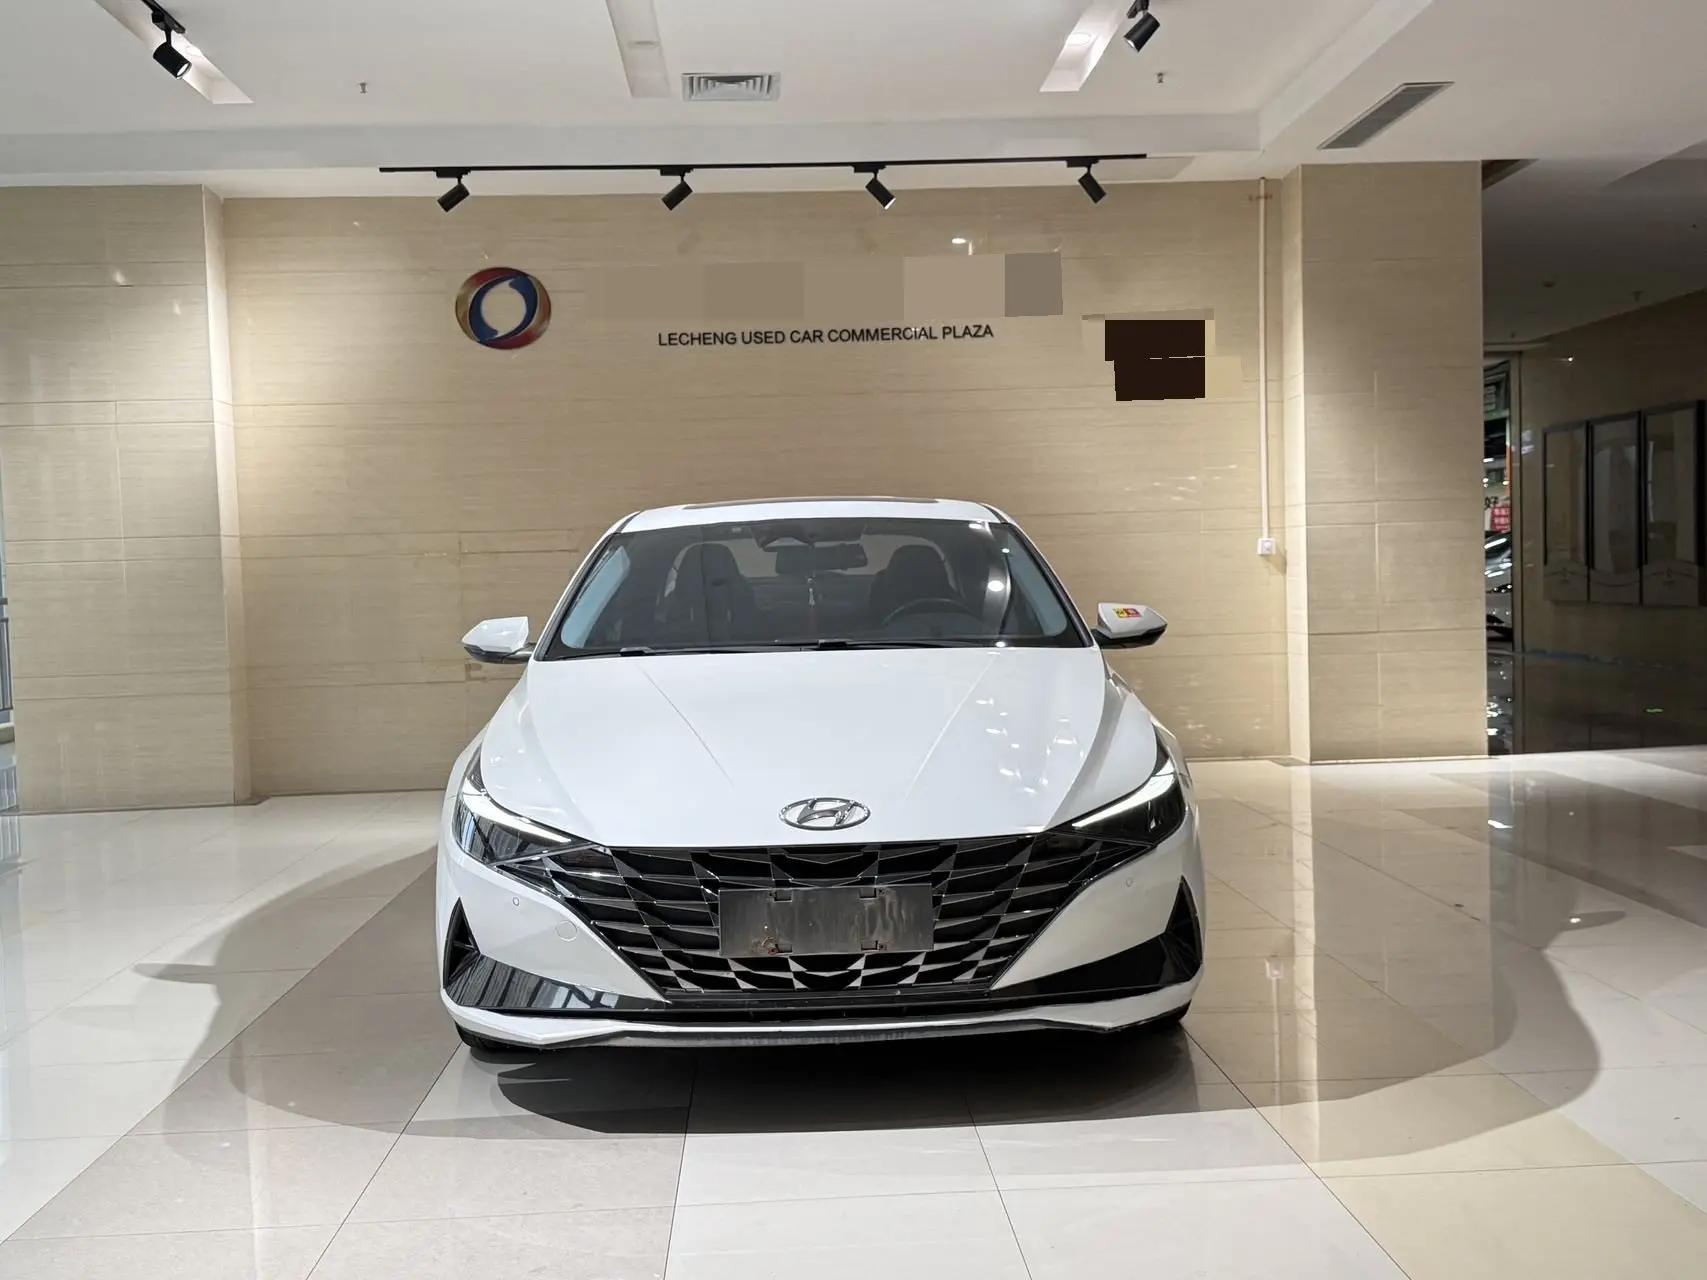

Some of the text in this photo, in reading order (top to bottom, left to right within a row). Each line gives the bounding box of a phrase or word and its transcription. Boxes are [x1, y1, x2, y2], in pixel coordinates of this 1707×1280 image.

[658, 324, 994, 346] LECHENG USED CAR COMMERCIAL PLAZA
